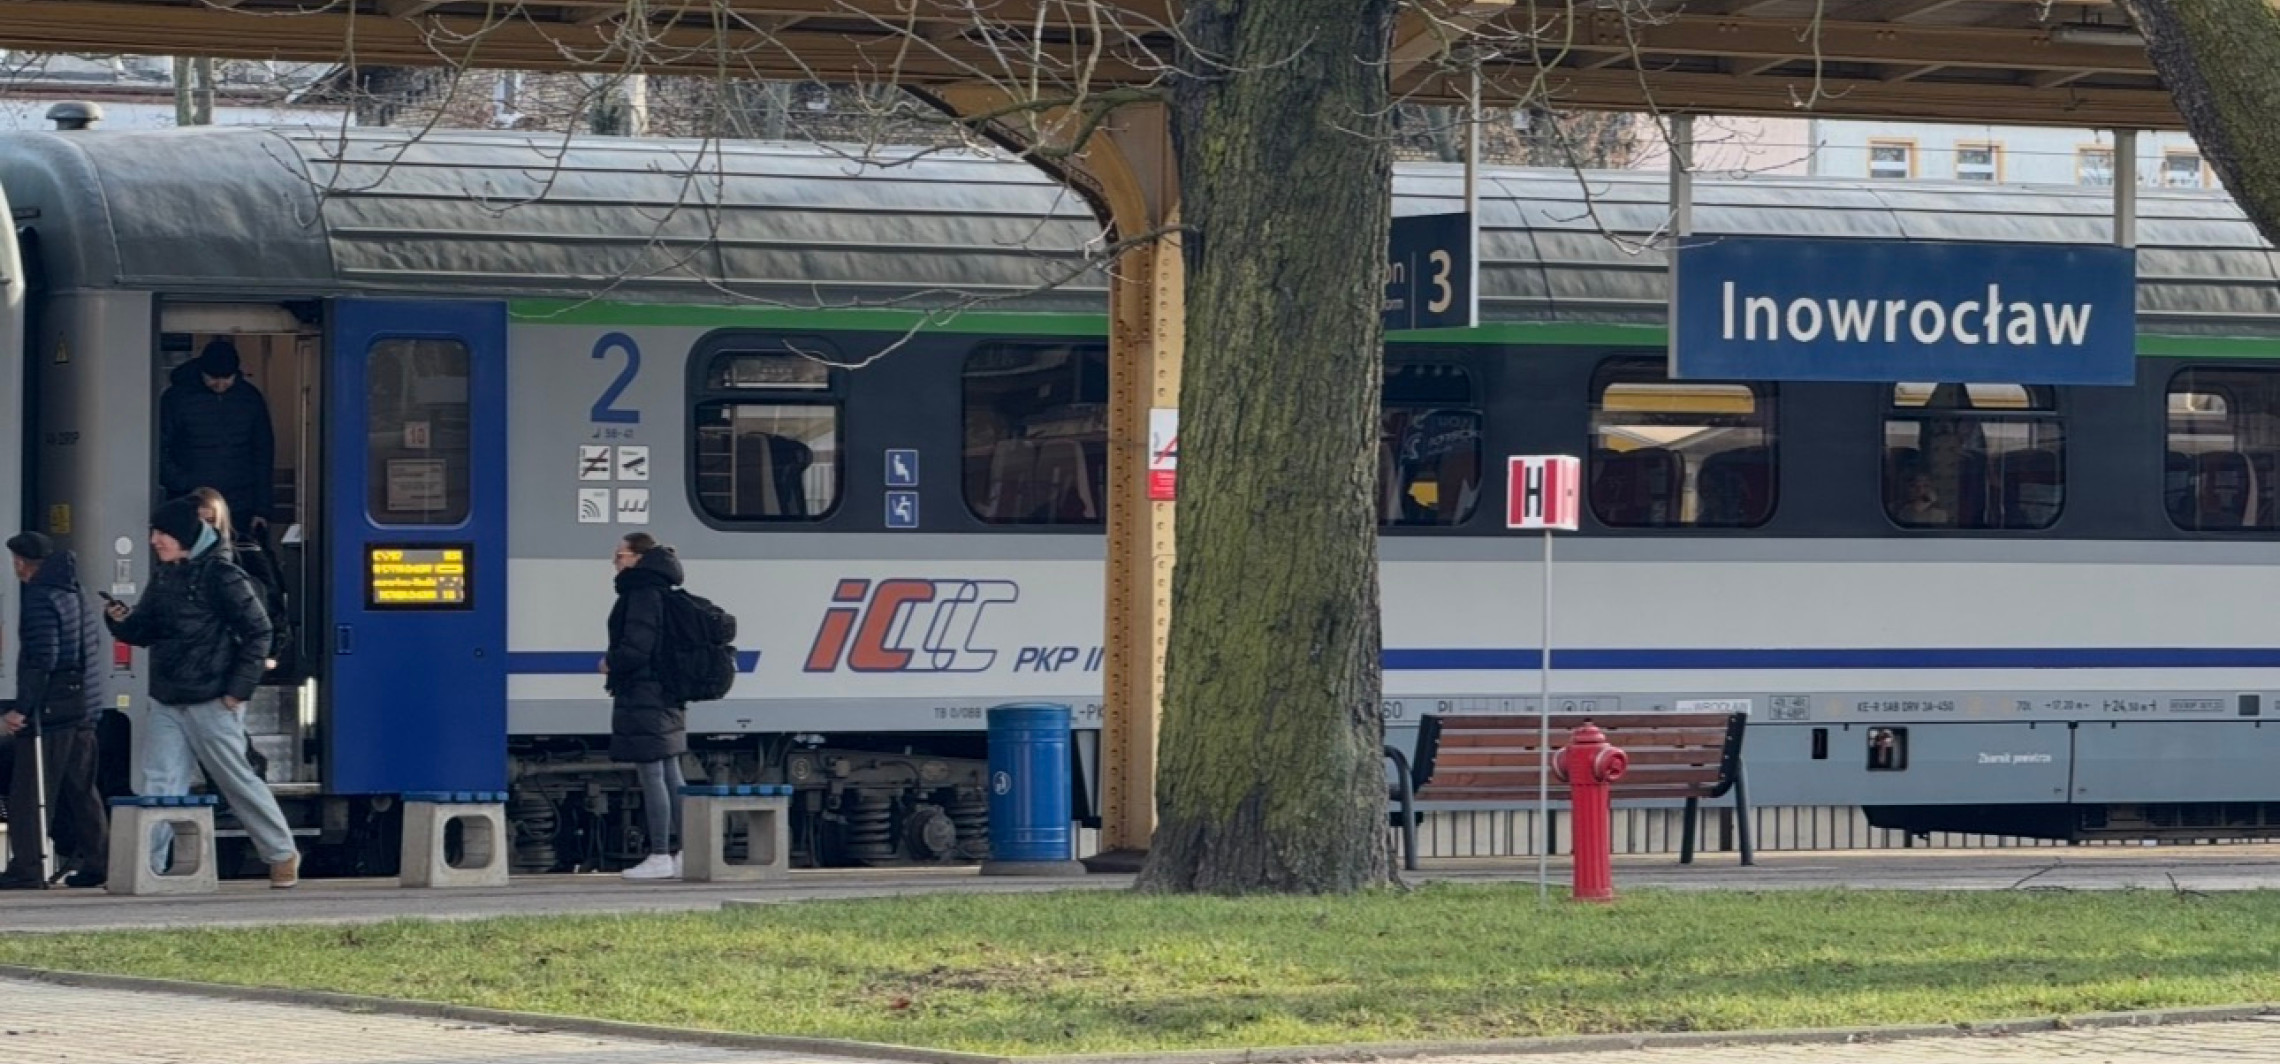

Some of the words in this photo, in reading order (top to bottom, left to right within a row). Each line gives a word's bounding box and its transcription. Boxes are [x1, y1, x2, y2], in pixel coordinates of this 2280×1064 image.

[1428, 249, 1452, 312] 3
[1722, 281, 2092, 346] Inowrocław
[591, 332, 640, 424] 2
[1525, 466, 1543, 518] H
[1012, 646, 1079, 672] PKP
